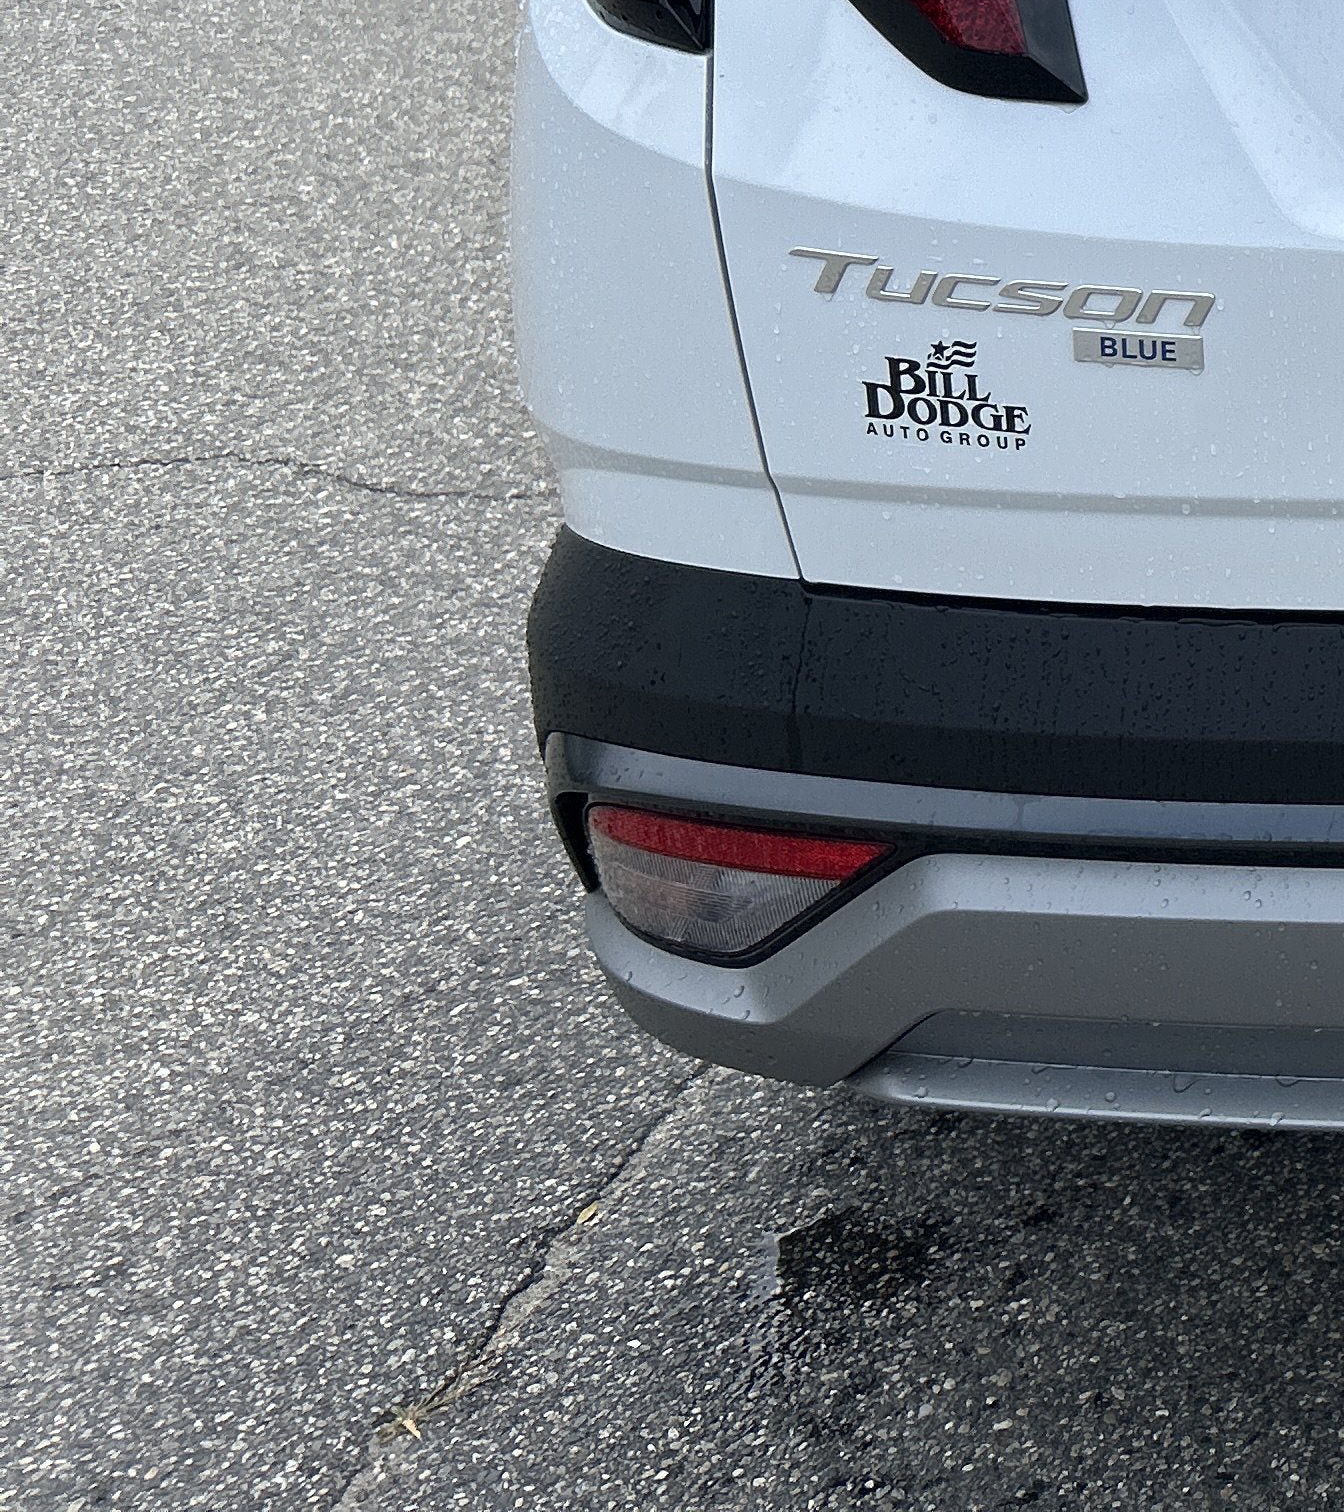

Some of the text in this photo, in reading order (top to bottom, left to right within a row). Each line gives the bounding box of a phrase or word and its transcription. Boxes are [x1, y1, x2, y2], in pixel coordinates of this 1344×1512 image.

[1099, 336, 1177, 362] BLUE
[862, 381, 1032, 435] DODGE
[866, 422, 1026, 451] AUTO GROUP
